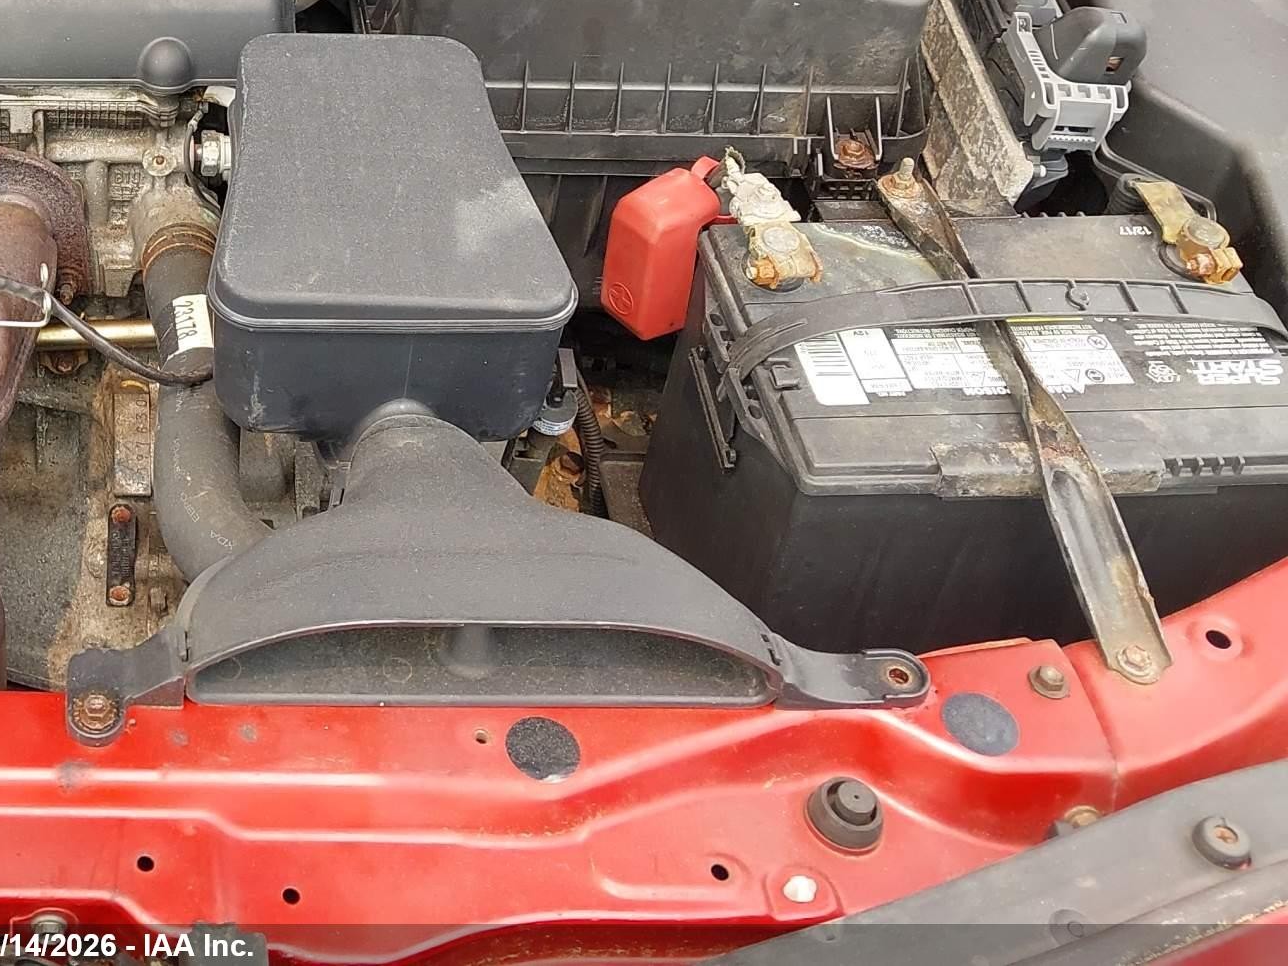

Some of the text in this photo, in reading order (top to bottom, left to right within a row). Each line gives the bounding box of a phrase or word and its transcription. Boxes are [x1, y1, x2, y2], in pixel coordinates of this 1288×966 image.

[1119, 225, 1153, 236] 12/17
[174, 300, 199, 341] 23178
[1192, 359, 1284, 375] START
[1198, 373, 1281, 386] SUPER
